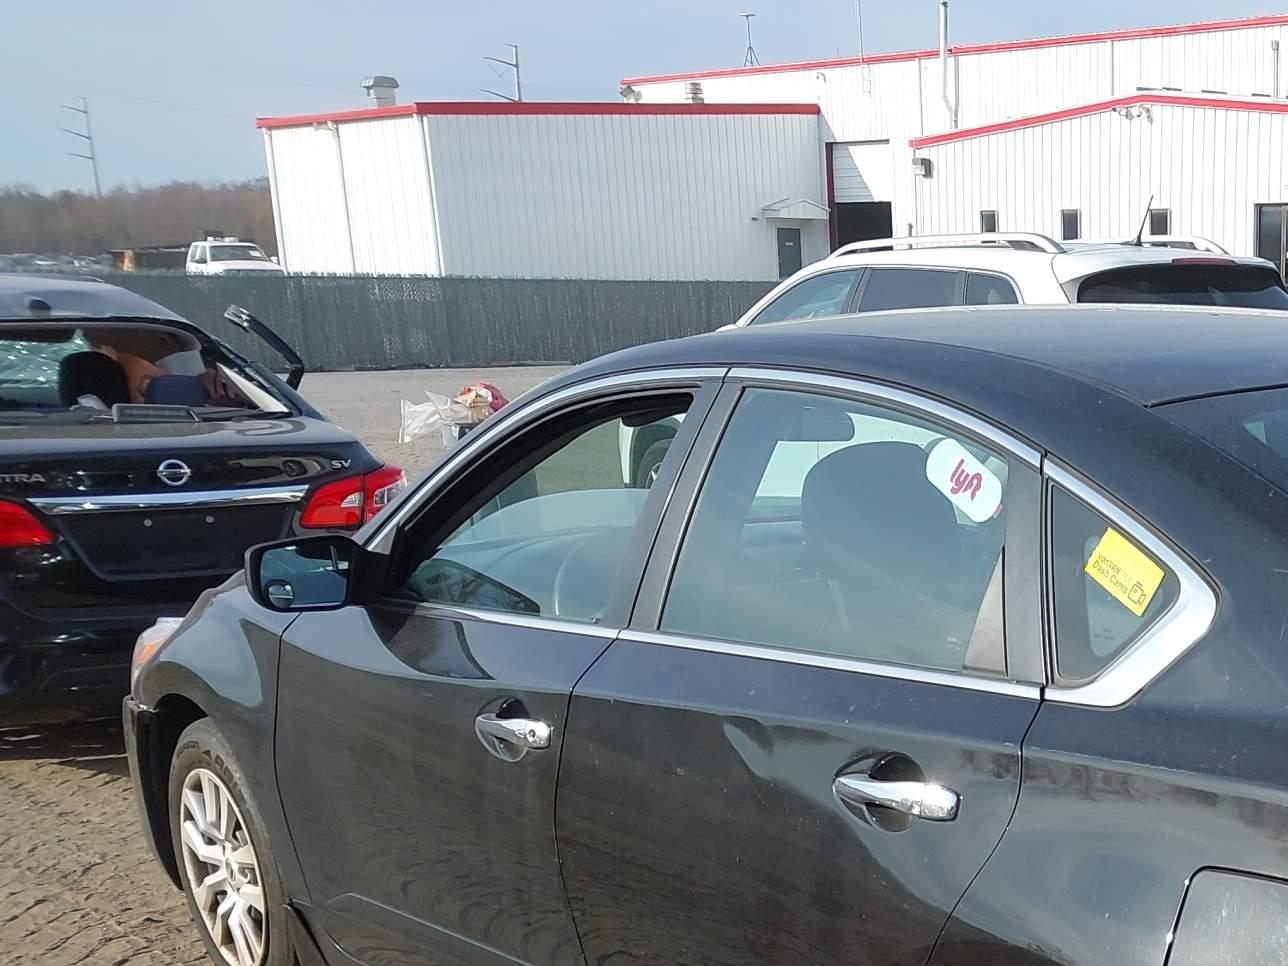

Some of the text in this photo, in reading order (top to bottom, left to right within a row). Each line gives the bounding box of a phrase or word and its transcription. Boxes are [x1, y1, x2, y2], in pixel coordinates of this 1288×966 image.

[332, 459, 352, 469] SV
[0, 473, 46, 483] TRA
[1092, 559, 1130, 594] Dash Cams
